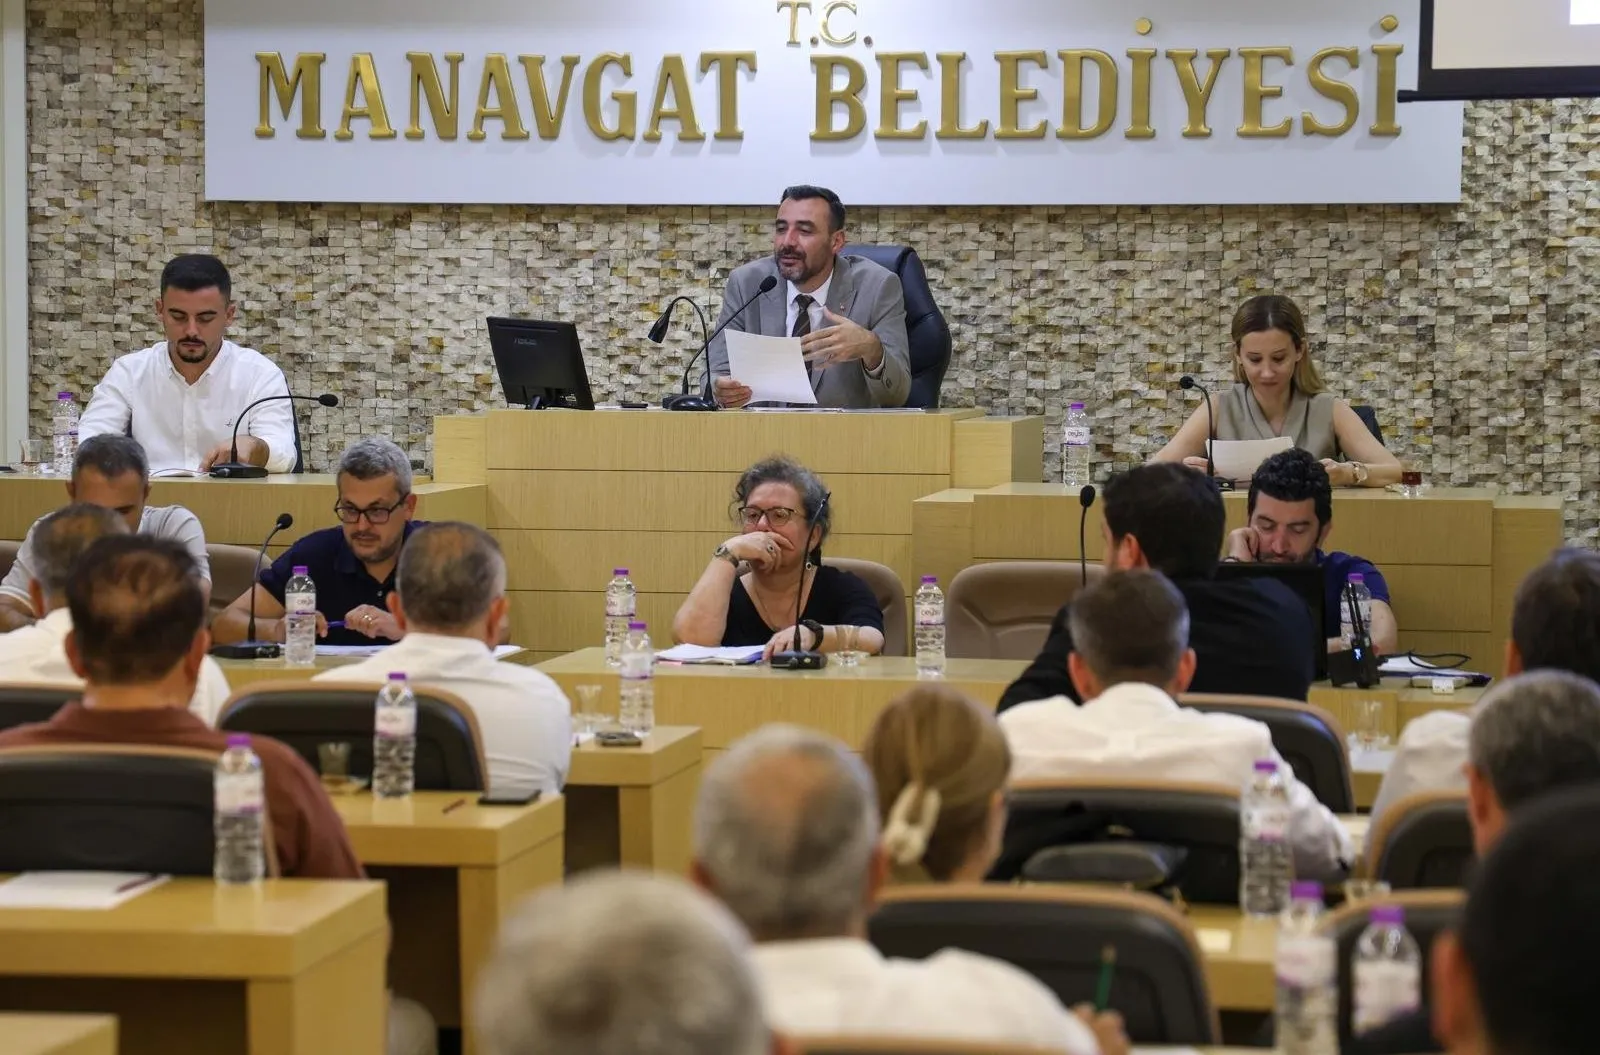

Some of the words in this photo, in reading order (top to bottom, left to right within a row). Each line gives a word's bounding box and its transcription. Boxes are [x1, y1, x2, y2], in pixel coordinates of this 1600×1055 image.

[777, 0, 874, 48] T.C.
[254, 51, 757, 141] MANAVGAT
[810, 15, 1404, 140] BELEDİYESİ
